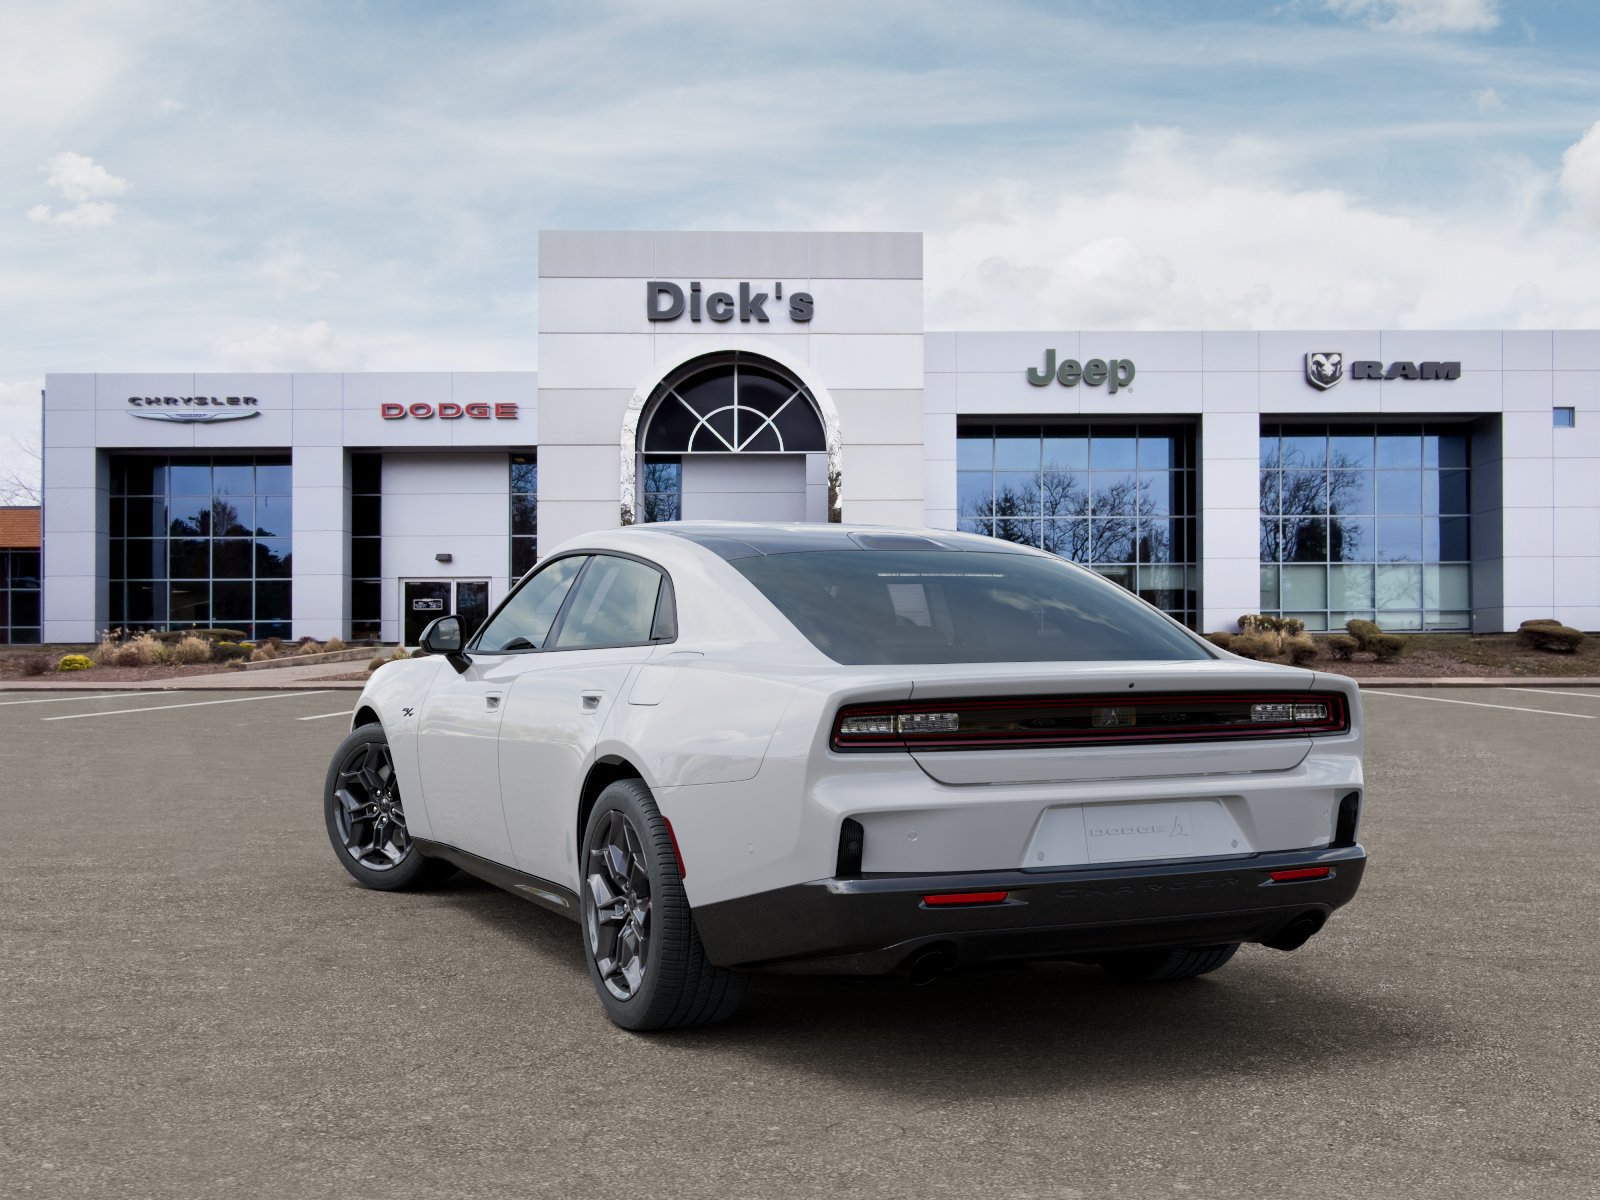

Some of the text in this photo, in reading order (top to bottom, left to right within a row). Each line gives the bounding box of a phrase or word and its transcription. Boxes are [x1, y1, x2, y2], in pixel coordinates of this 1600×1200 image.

[647, 281, 814, 322] Dick's
[1027, 348, 1136, 394] Jeep
[1352, 361, 1461, 380] RAM
[127, 396, 259, 407] CHRYSLER
[381, 402, 519, 420] DODGE
